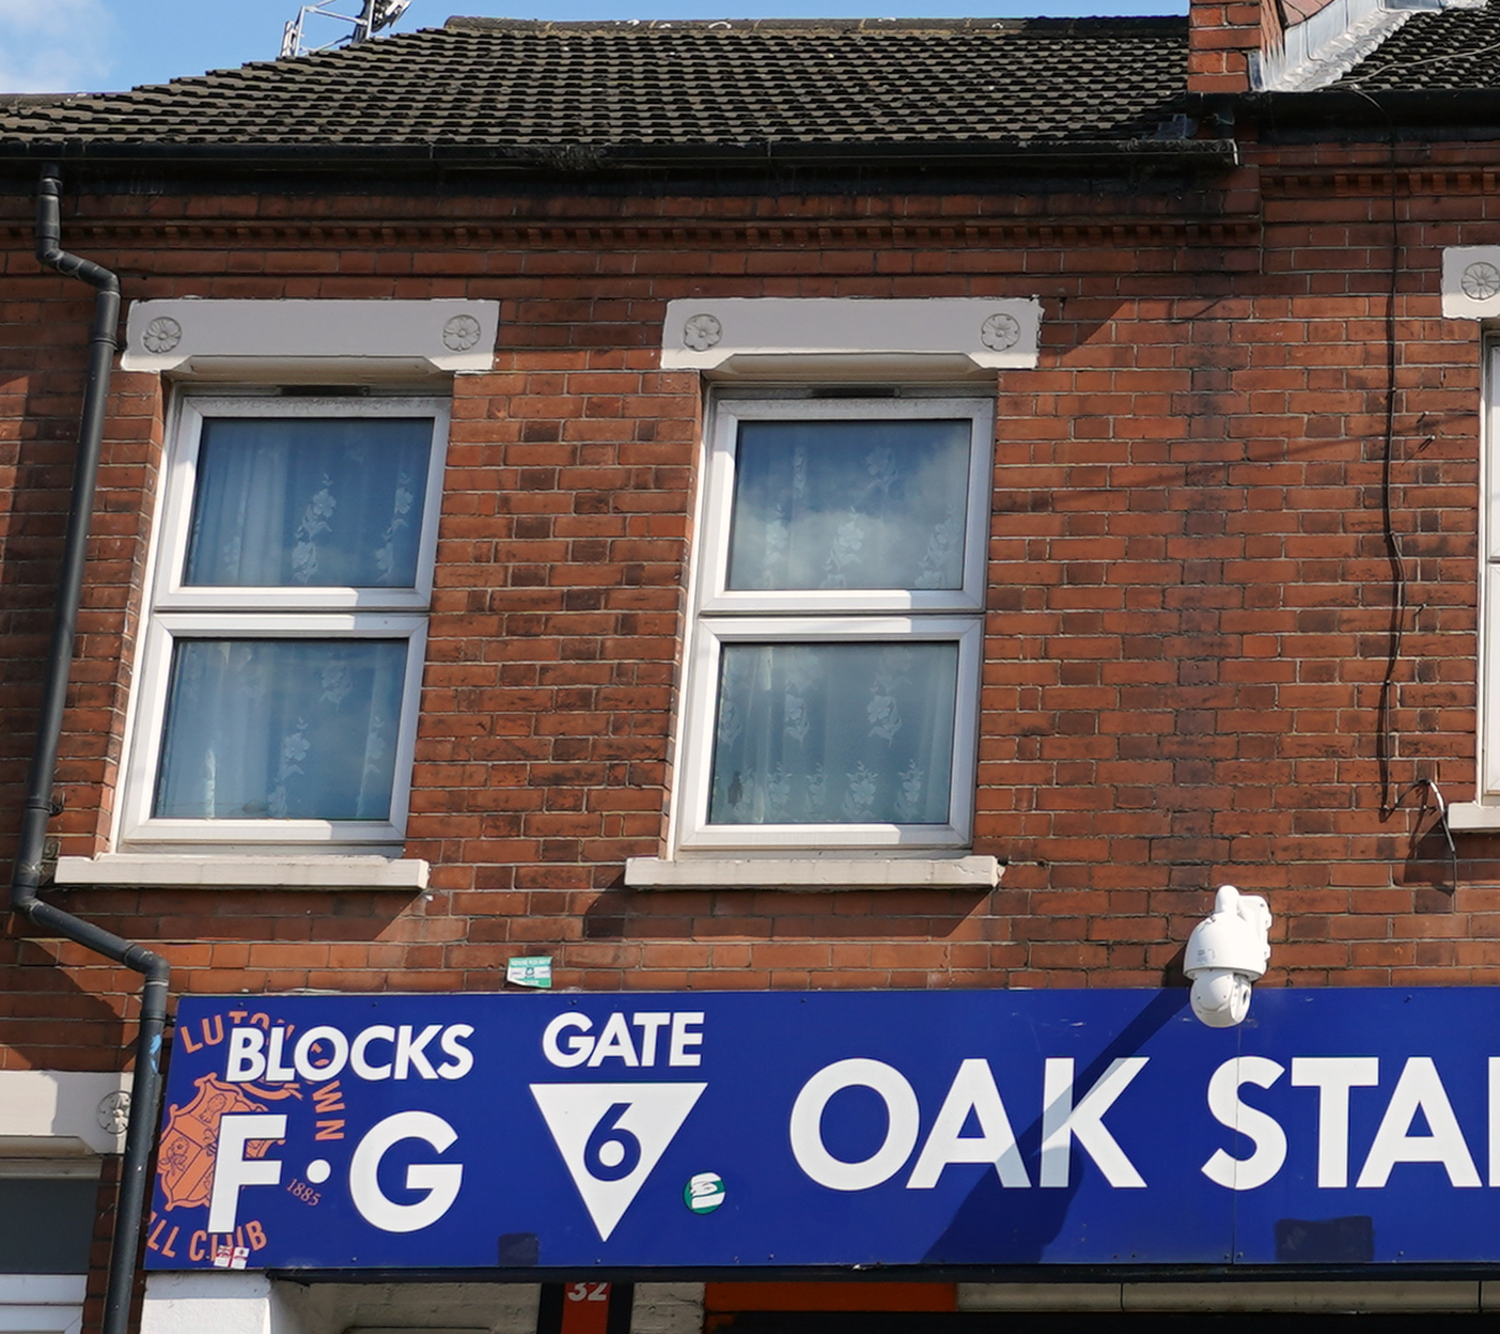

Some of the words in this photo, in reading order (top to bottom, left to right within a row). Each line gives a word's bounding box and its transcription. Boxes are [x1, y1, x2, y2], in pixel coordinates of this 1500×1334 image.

[227, 1024, 474, 1081] BLOCKS
[543, 1013, 704, 1067] GATE
[583, 1102, 642, 1182] 6
[790, 1058, 1150, 1190] OAK
[286, 1178, 322, 1206] 1885
[567, 1282, 608, 1301] 32
